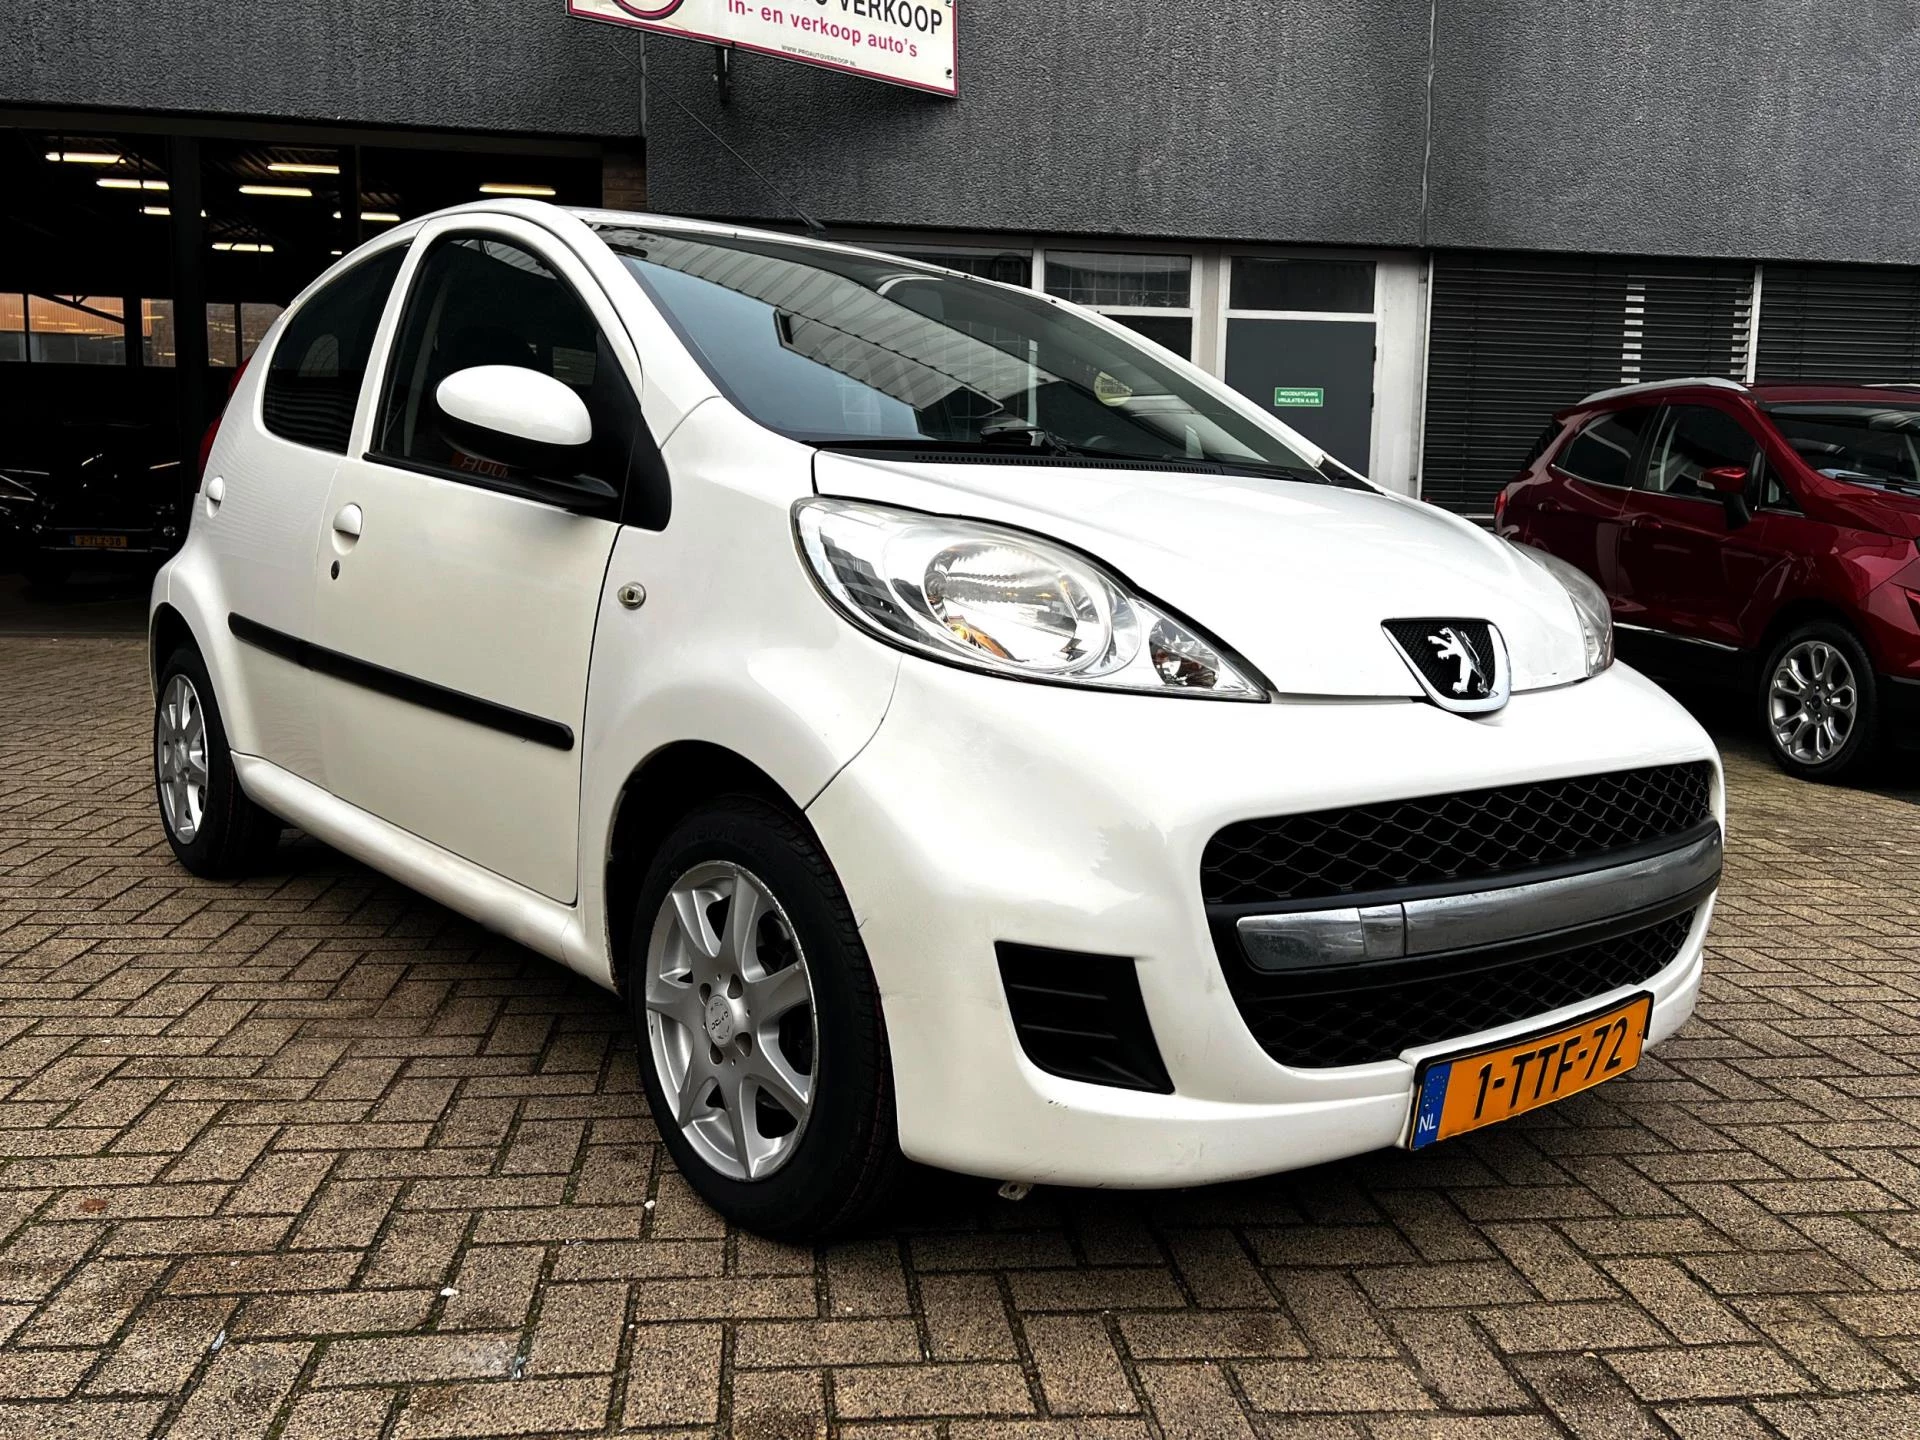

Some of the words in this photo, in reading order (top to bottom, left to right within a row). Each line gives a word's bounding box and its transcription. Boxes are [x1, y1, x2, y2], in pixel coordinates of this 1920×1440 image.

[761, 7, 783, 25] en
[790, 13, 862, 46] verkoop
[868, 33, 918, 58] auto's
[1474, 1016, 1628, 1120] 1-TTF-72
[1418, 1114, 1436, 1133] NL
